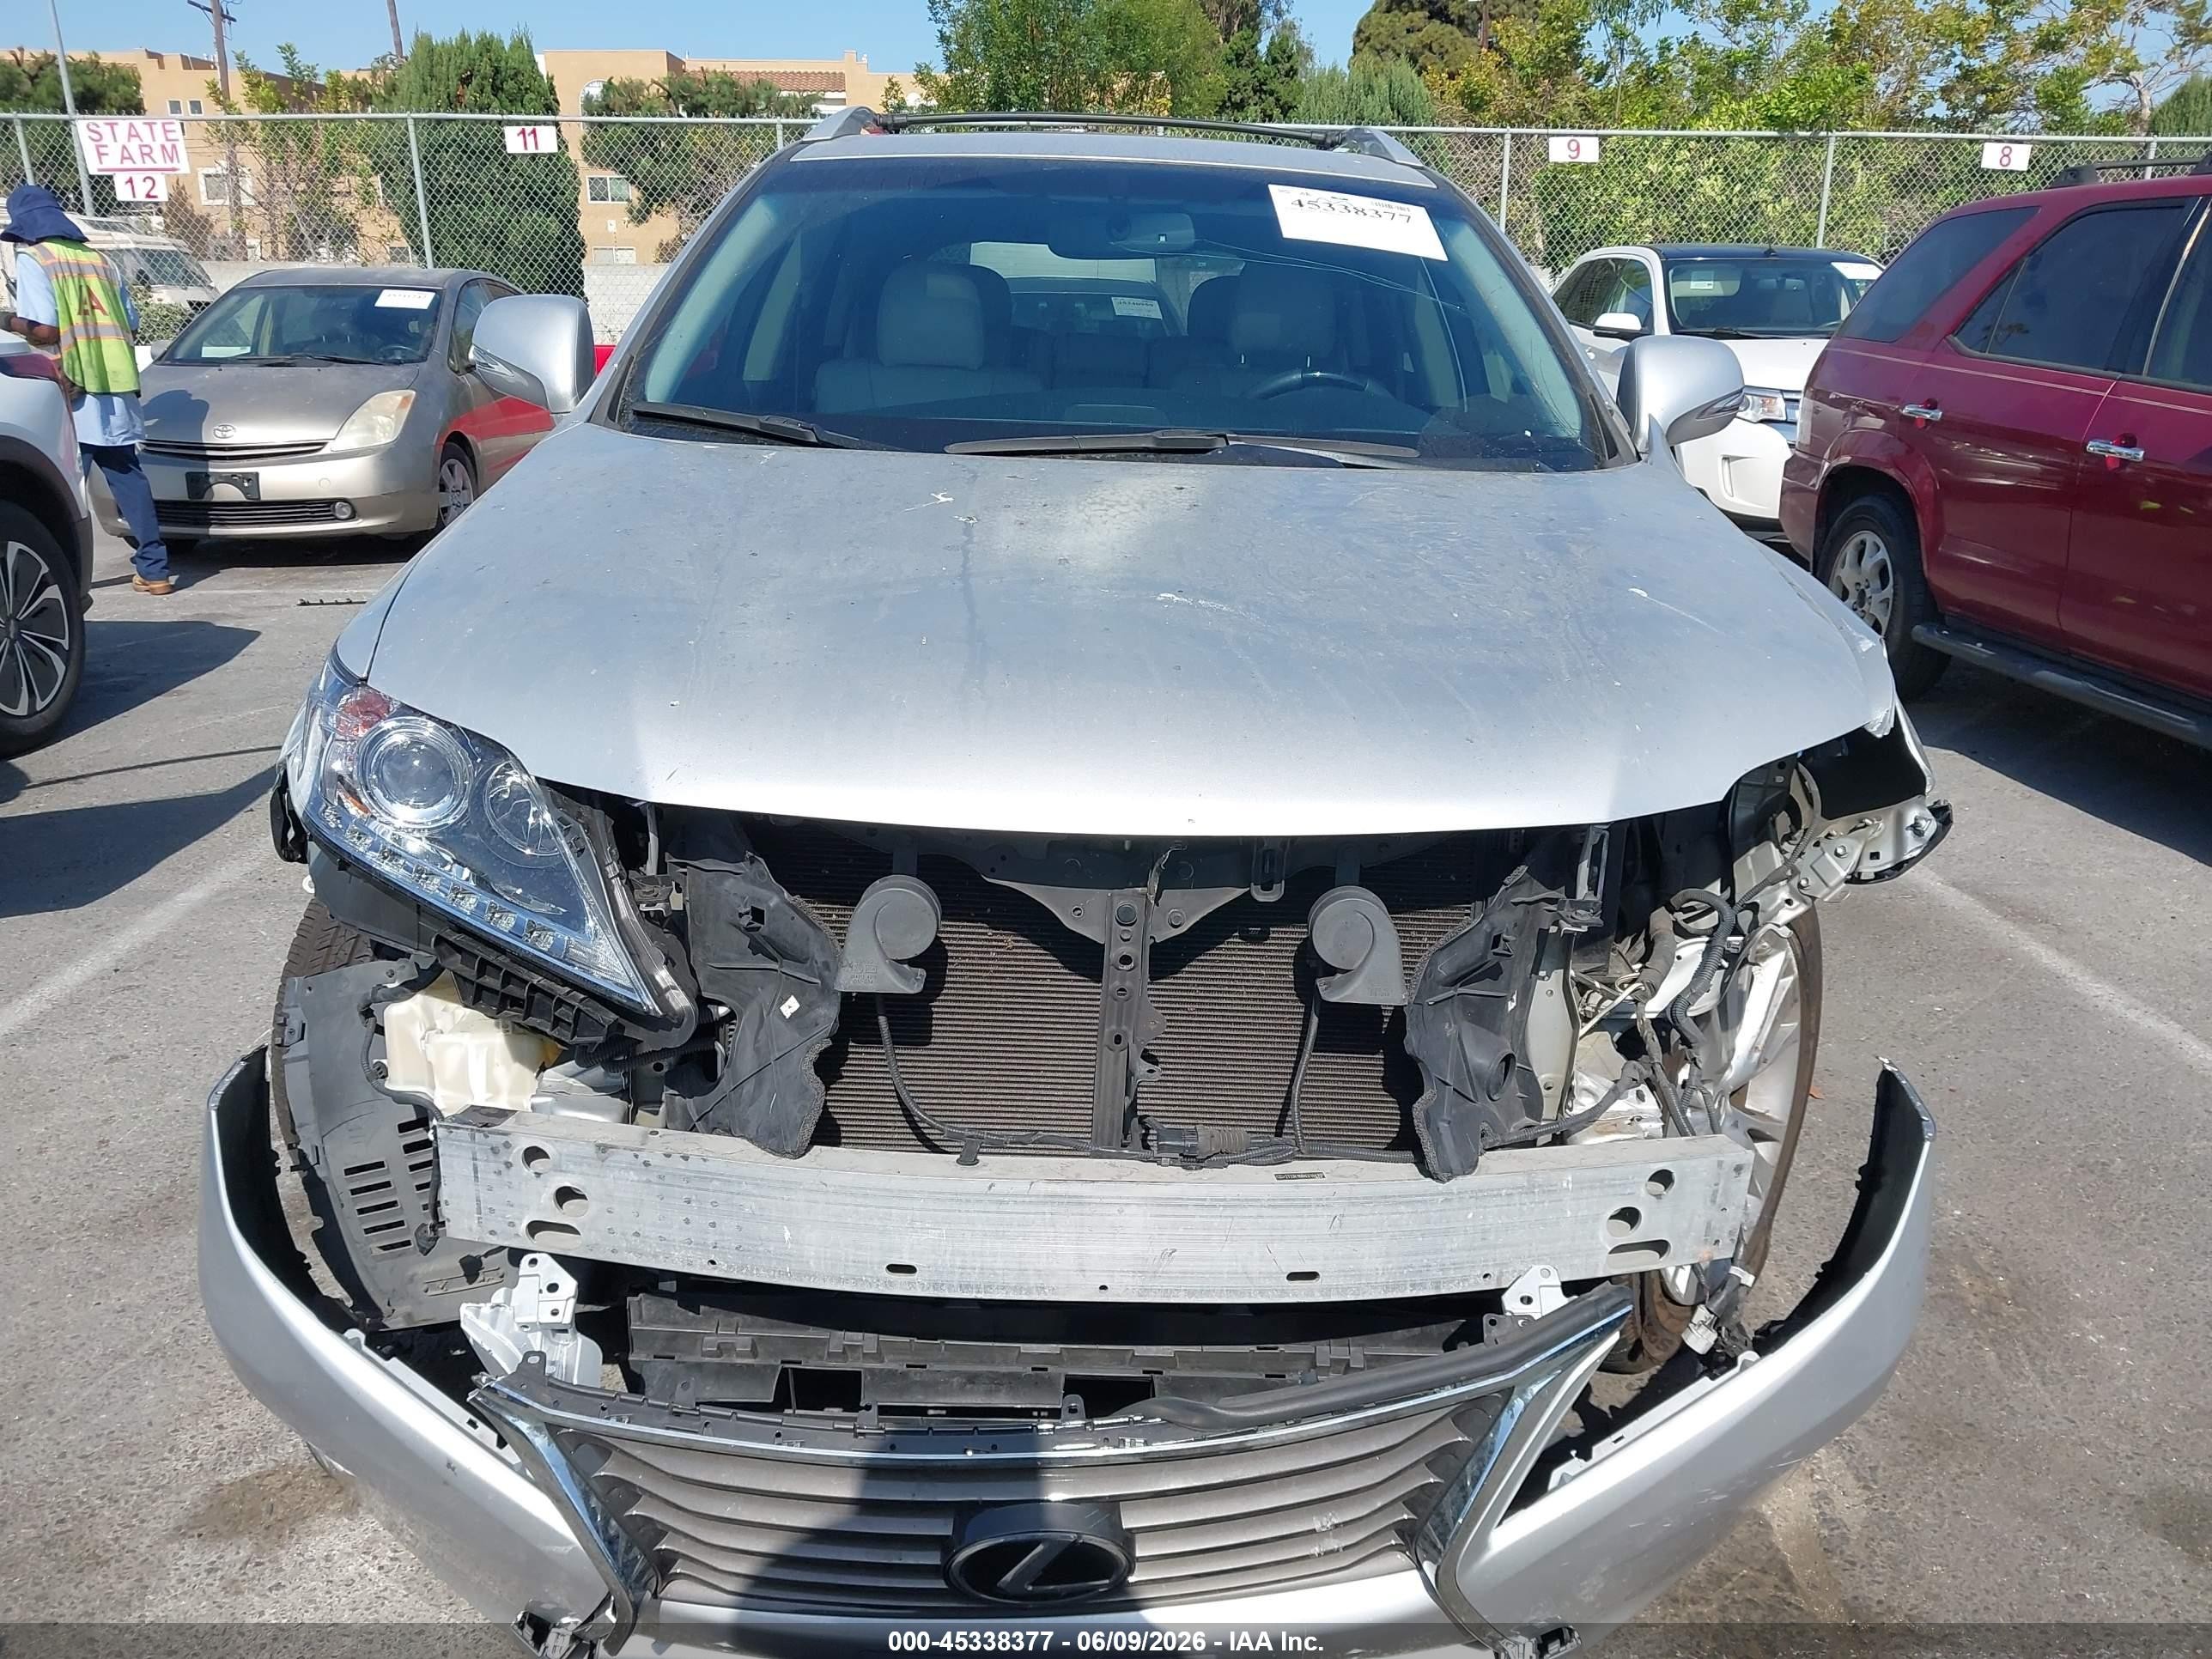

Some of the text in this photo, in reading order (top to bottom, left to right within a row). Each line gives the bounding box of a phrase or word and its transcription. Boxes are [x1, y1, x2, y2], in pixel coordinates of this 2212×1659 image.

[86, 121, 179, 143] STATE
[516, 127, 539, 150] 11
[94, 143, 180, 165] FARM
[1567, 138, 1581, 160] 9
[1999, 145, 2013, 167] 8
[125, 175, 159, 199] 12
[1291, 198, 1411, 223] 45338377
